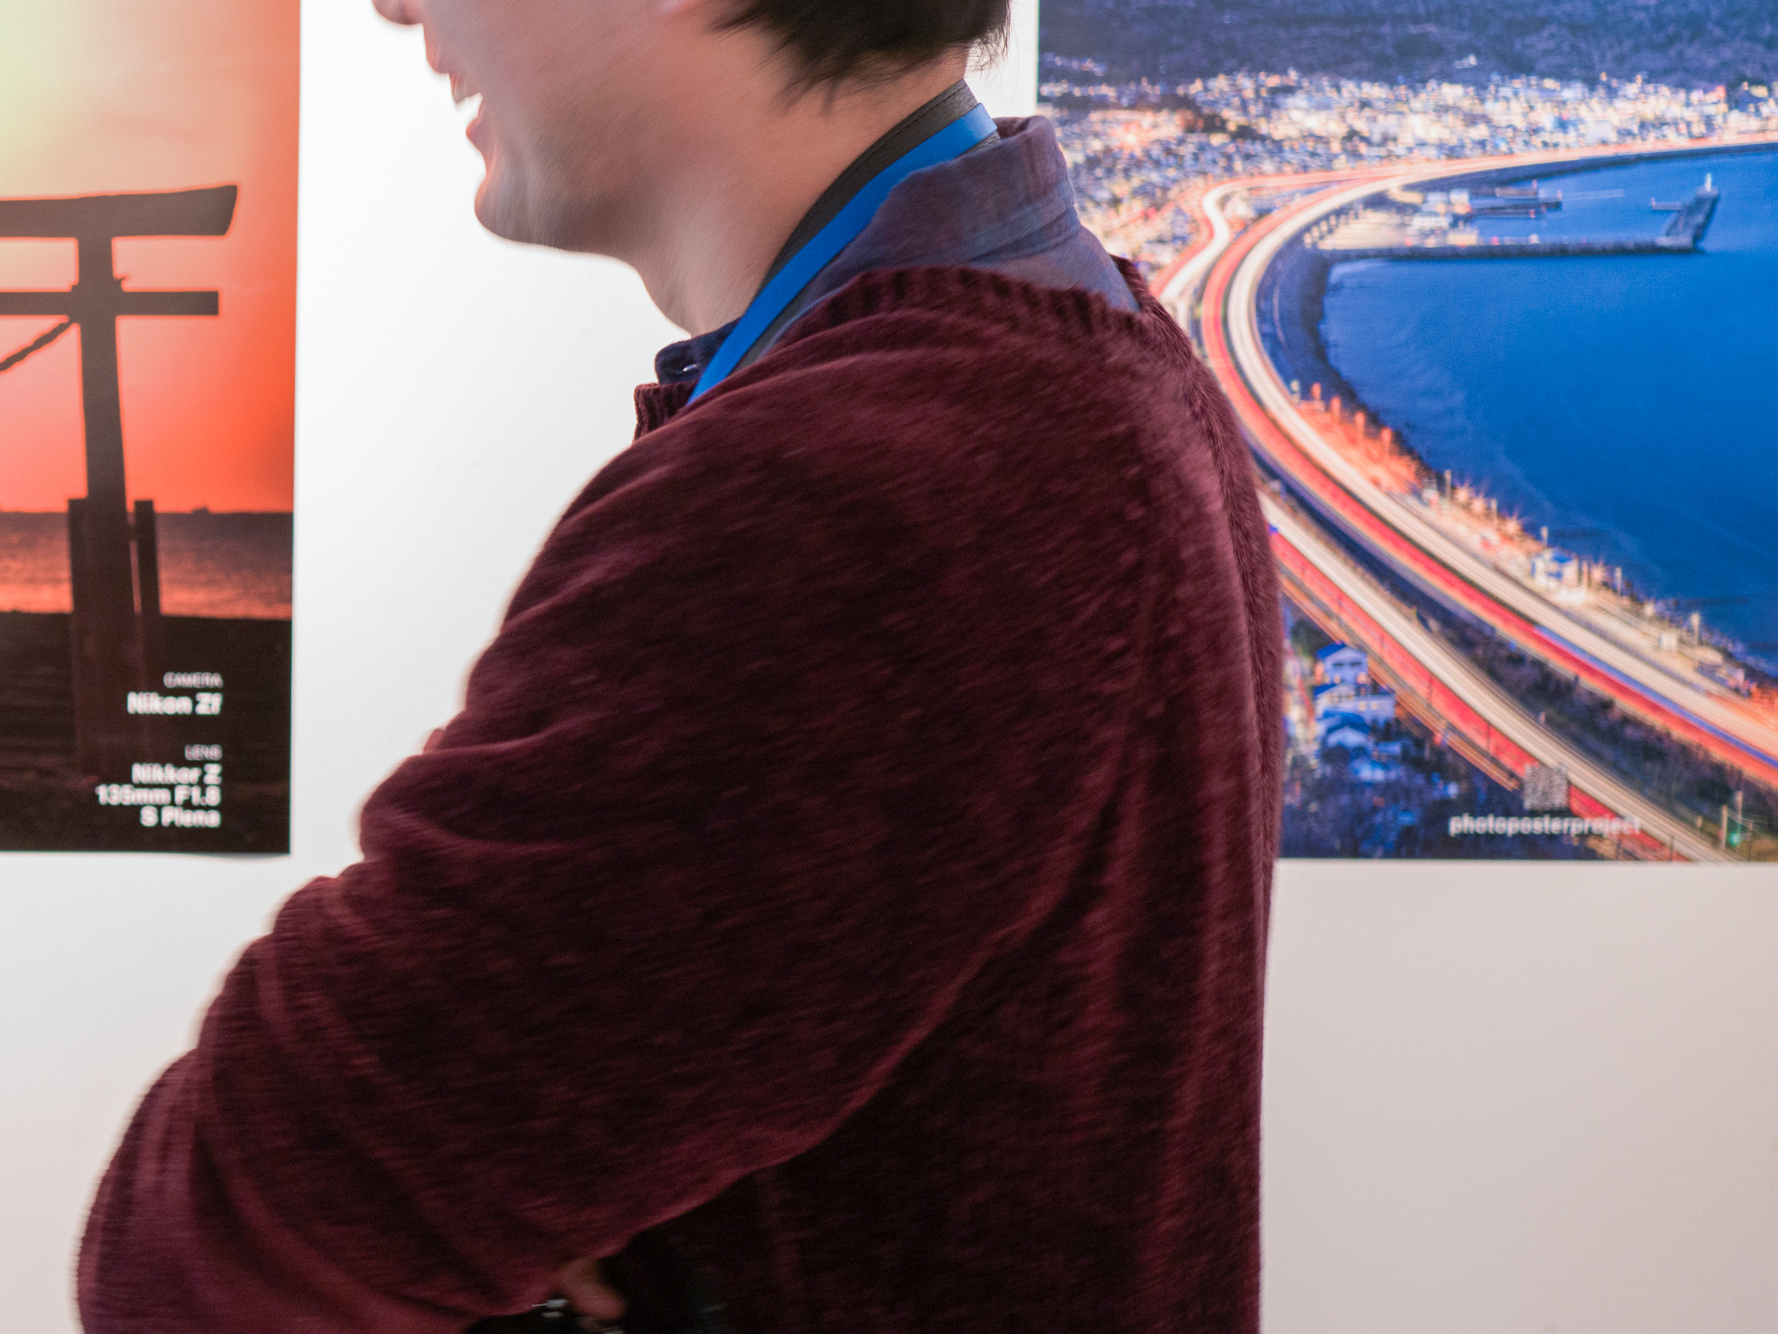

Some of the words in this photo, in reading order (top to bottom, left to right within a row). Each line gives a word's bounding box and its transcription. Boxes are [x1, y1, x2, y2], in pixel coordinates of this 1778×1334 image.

[163, 672, 223, 688] CAMERA
[127, 692, 193, 714] Nikon
[195, 692, 222, 714] Zf
[185, 744, 222, 760] LENS
[132, 763, 202, 784] Nikkor
[203, 763, 222, 784] Z
[96, 784, 171, 805] 135mm
[174, 785, 221, 805] F1.8
[140, 806, 158, 827] S
[161, 806, 221, 827] Plena
[1448, 813, 1641, 837] photoposterproject
